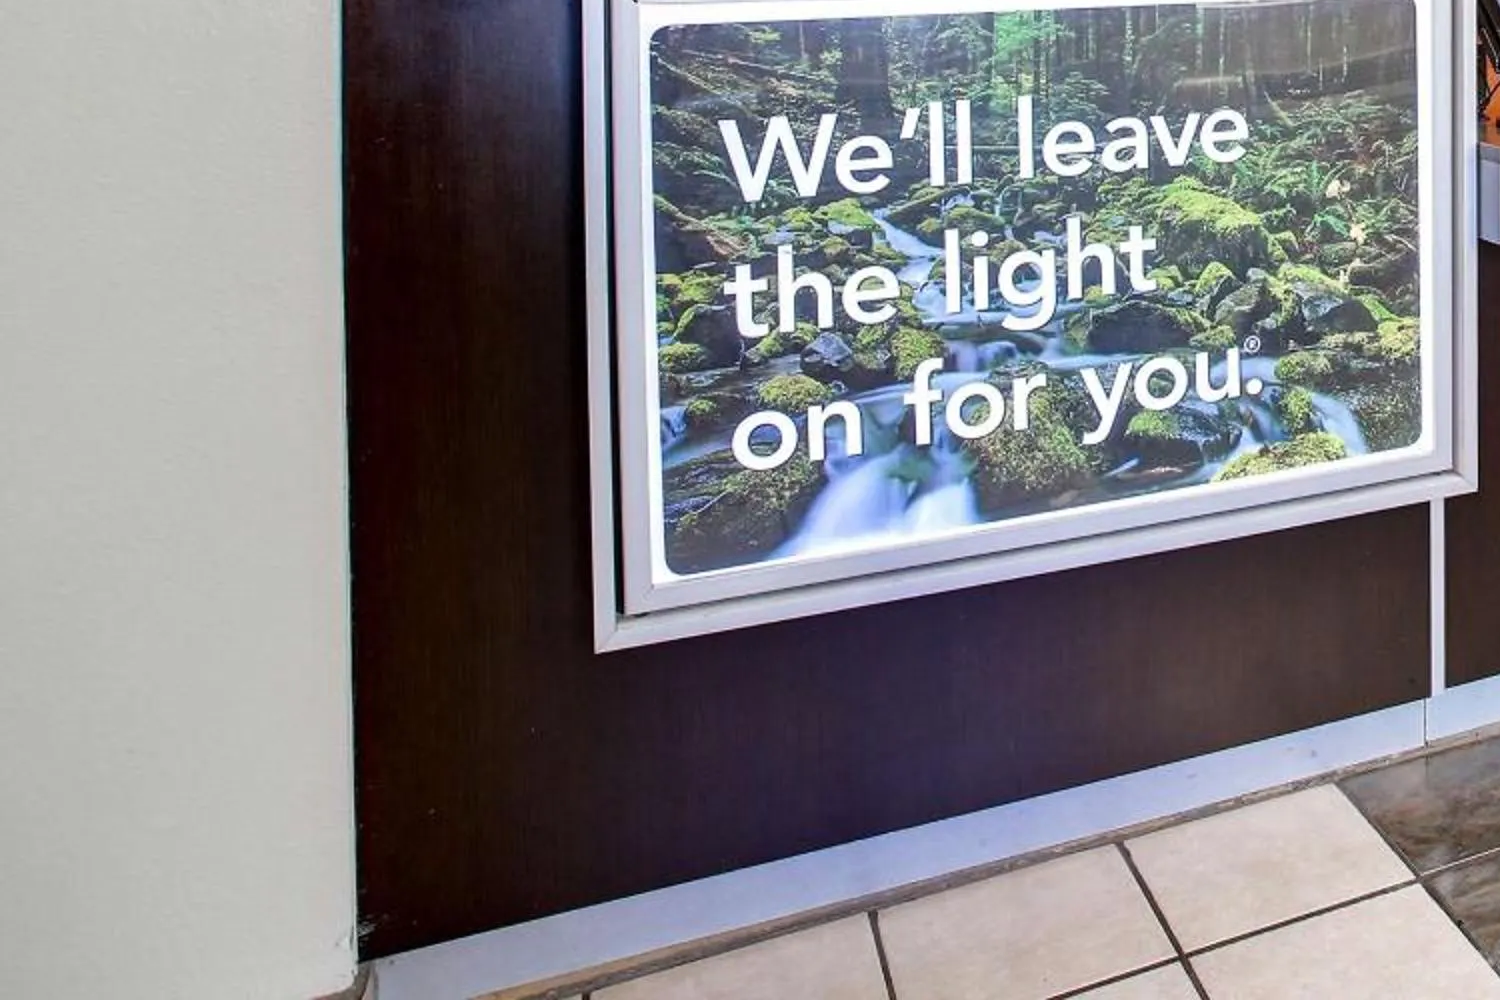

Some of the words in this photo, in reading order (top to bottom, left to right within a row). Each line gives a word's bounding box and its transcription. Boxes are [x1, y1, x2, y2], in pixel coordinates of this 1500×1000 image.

[717, 98, 972, 203] We'll
[1017, 94, 1249, 180] leave
[723, 243, 900, 338] the
[944, 215, 1157, 331] light
[731, 400, 863, 471] on
[903, 357, 1047, 446] for
